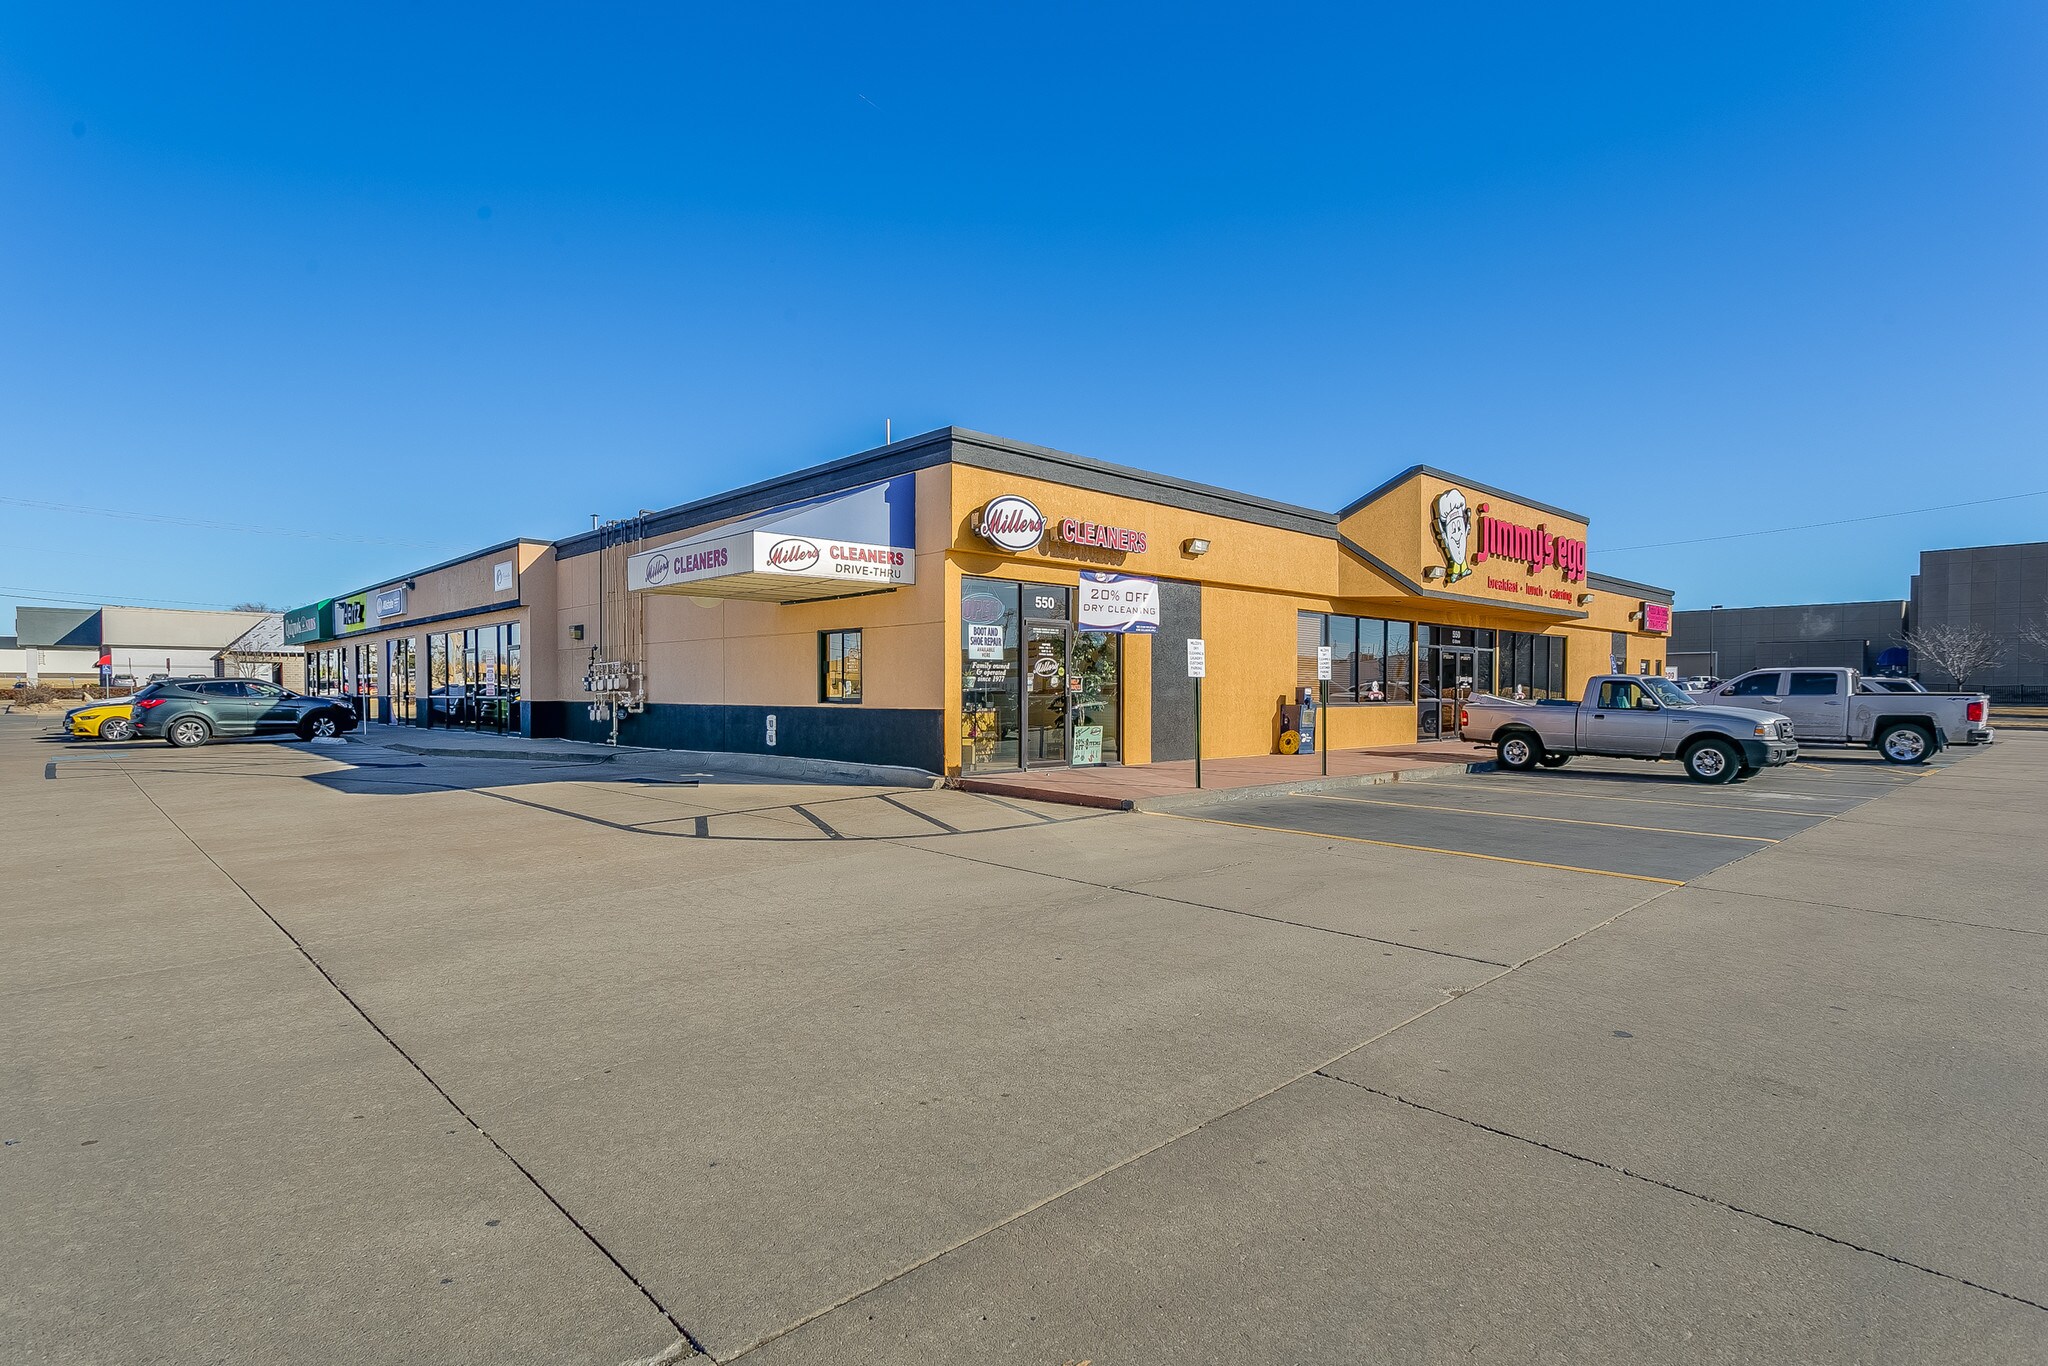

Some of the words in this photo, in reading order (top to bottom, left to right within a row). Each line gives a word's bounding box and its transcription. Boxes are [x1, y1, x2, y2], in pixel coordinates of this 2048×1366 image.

[982, 508, 1047, 535] Millers
[1063, 518, 1148, 553] CLEANERS
[1477, 503, 1555, 573] jimmy's
[1558, 536, 1586, 581] egg
[645, 560, 670, 582] Millers
[673, 547, 728, 575] CLEANERS
[767, 545, 821, 566] Millers
[829, 545, 904, 566] CLEANERS
[835, 563, 901, 579] DRIVE-THRU
[1090, 588, 1120, 601] 20%
[1125, 591, 1149, 602] OFF
[1487, 576, 1518, 593] breakfast
[1526, 583, 1543, 597] lunch
[1549, 589, 1572, 604] catering
[1035, 596, 1055, 609] 550
[1083, 603, 1104, 612] DRY
[343, 602, 364, 624] Hertz
[973, 627, 987, 636] BOOT
[988, 627, 999, 637] AND
[970, 637, 983, 646] SHOE
[984, 637, 1002, 647] REPAIR
[972, 662, 991, 671] Family
